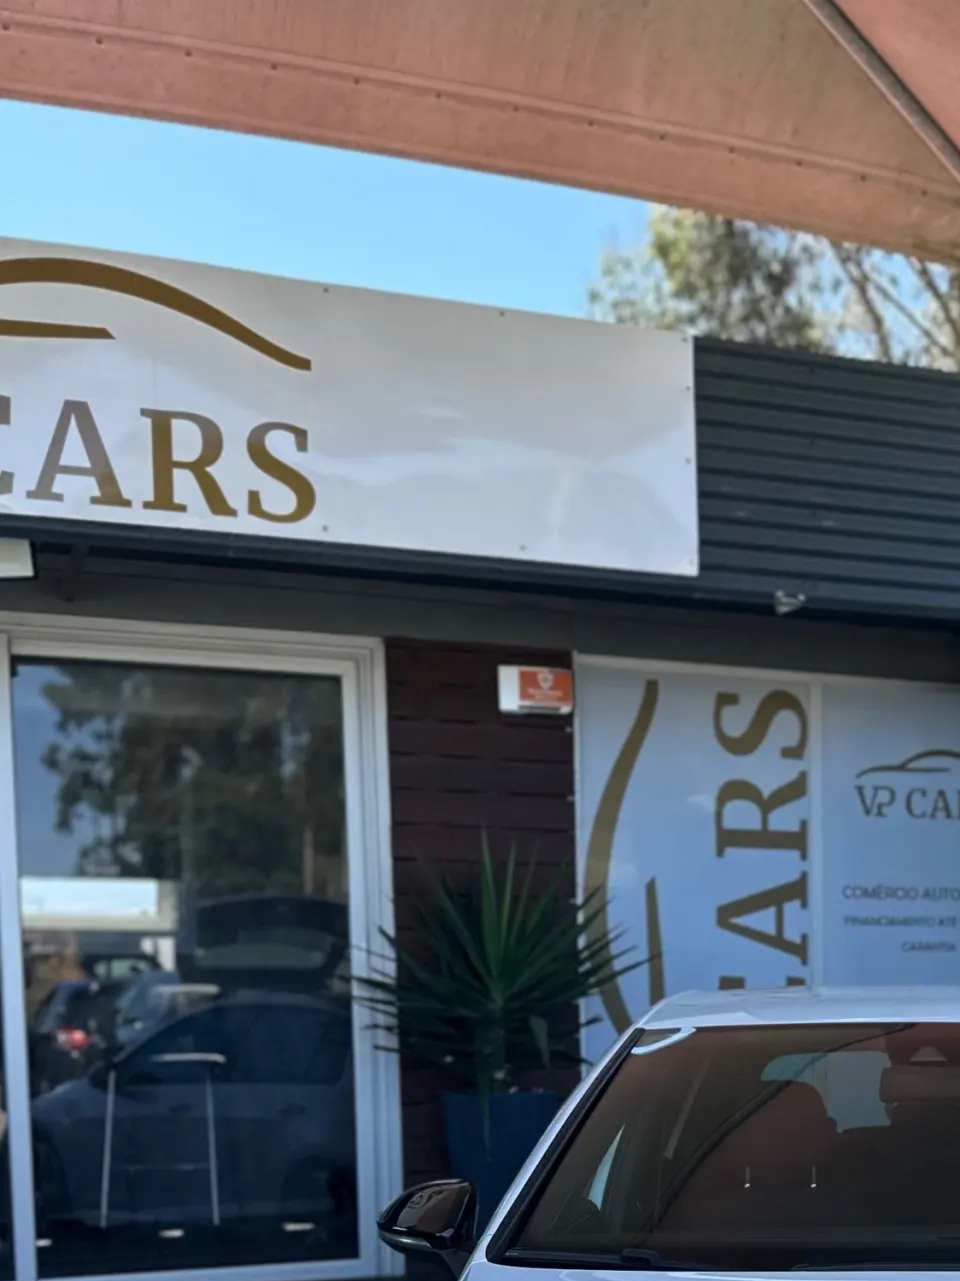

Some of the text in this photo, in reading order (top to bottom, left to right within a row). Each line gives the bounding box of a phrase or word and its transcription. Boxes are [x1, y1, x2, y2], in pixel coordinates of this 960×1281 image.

[0, 394, 316, 523] ARS
[713, 688, 808, 990] ARS
[854, 784, 896, 818] VP
